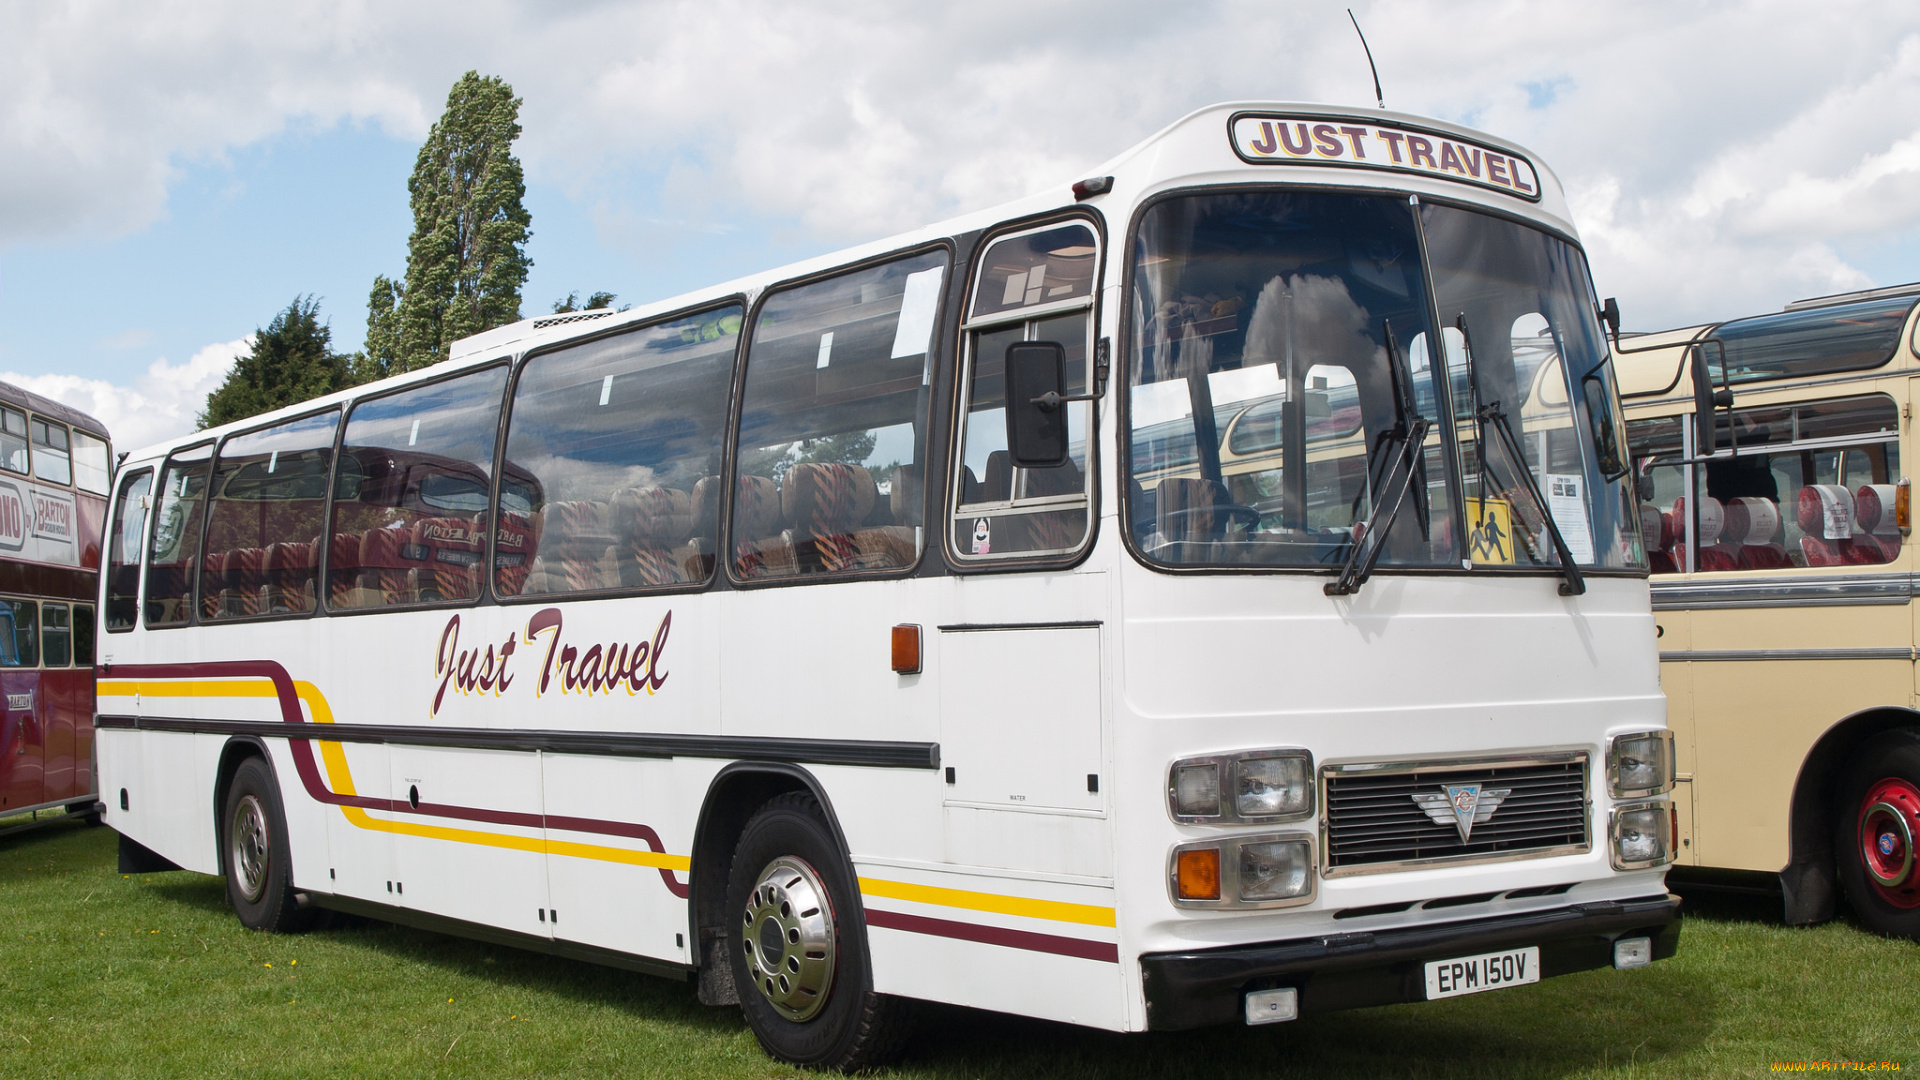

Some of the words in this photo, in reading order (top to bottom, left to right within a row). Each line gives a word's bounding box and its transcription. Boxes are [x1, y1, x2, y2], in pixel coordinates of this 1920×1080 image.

[1250, 121, 1368, 160] JUST
[1377, 129, 1533, 195] TRAVEL
[37, 498, 70, 536] BARTON
[430, 613, 516, 719] Just
[524, 607, 672, 699] Travel
[1438, 959, 1479, 993] EPM
[1483, 952, 1526, 985] 150V
